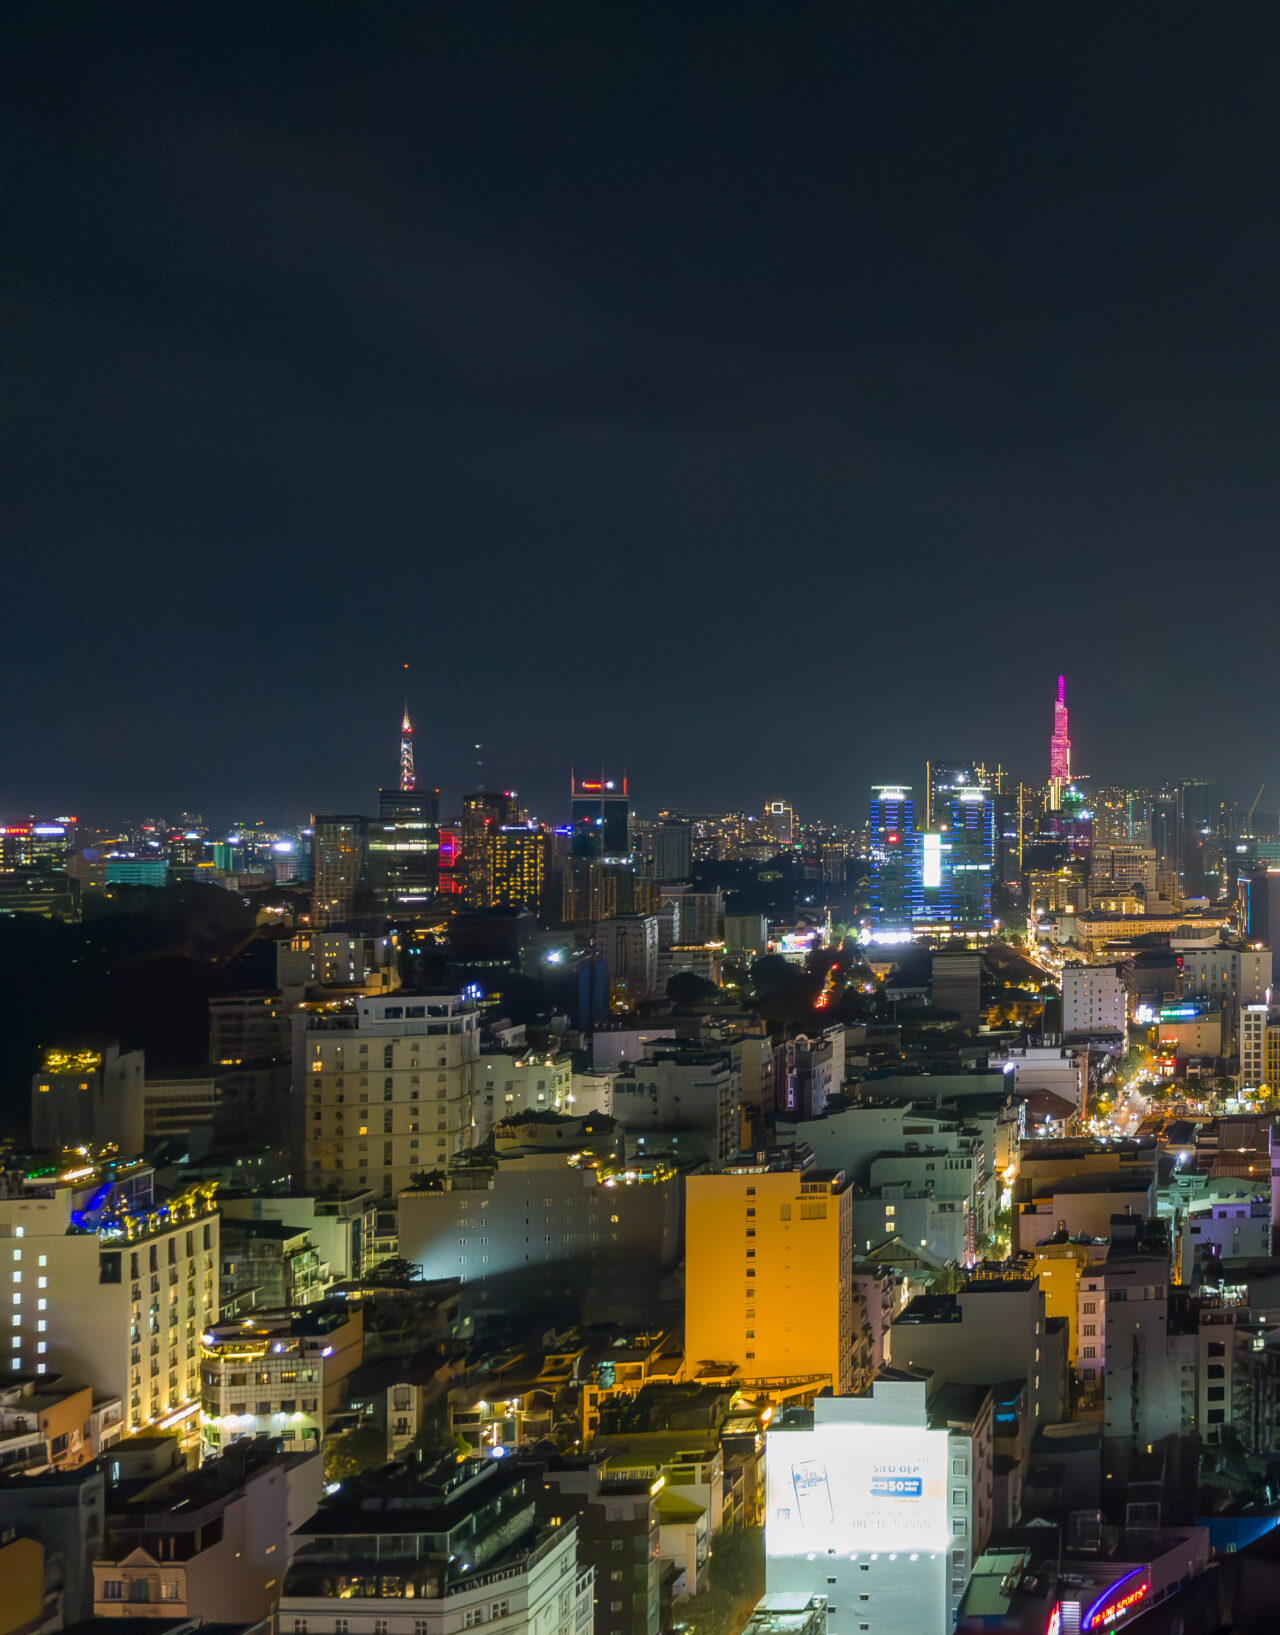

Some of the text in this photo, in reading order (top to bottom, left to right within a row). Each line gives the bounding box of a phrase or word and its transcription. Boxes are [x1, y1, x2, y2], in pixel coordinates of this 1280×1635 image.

[888, 1481, 904, 1492] 50
[1091, 1605, 1116, 1627] TRANG
[1116, 1589, 1143, 1609] SPORTS
